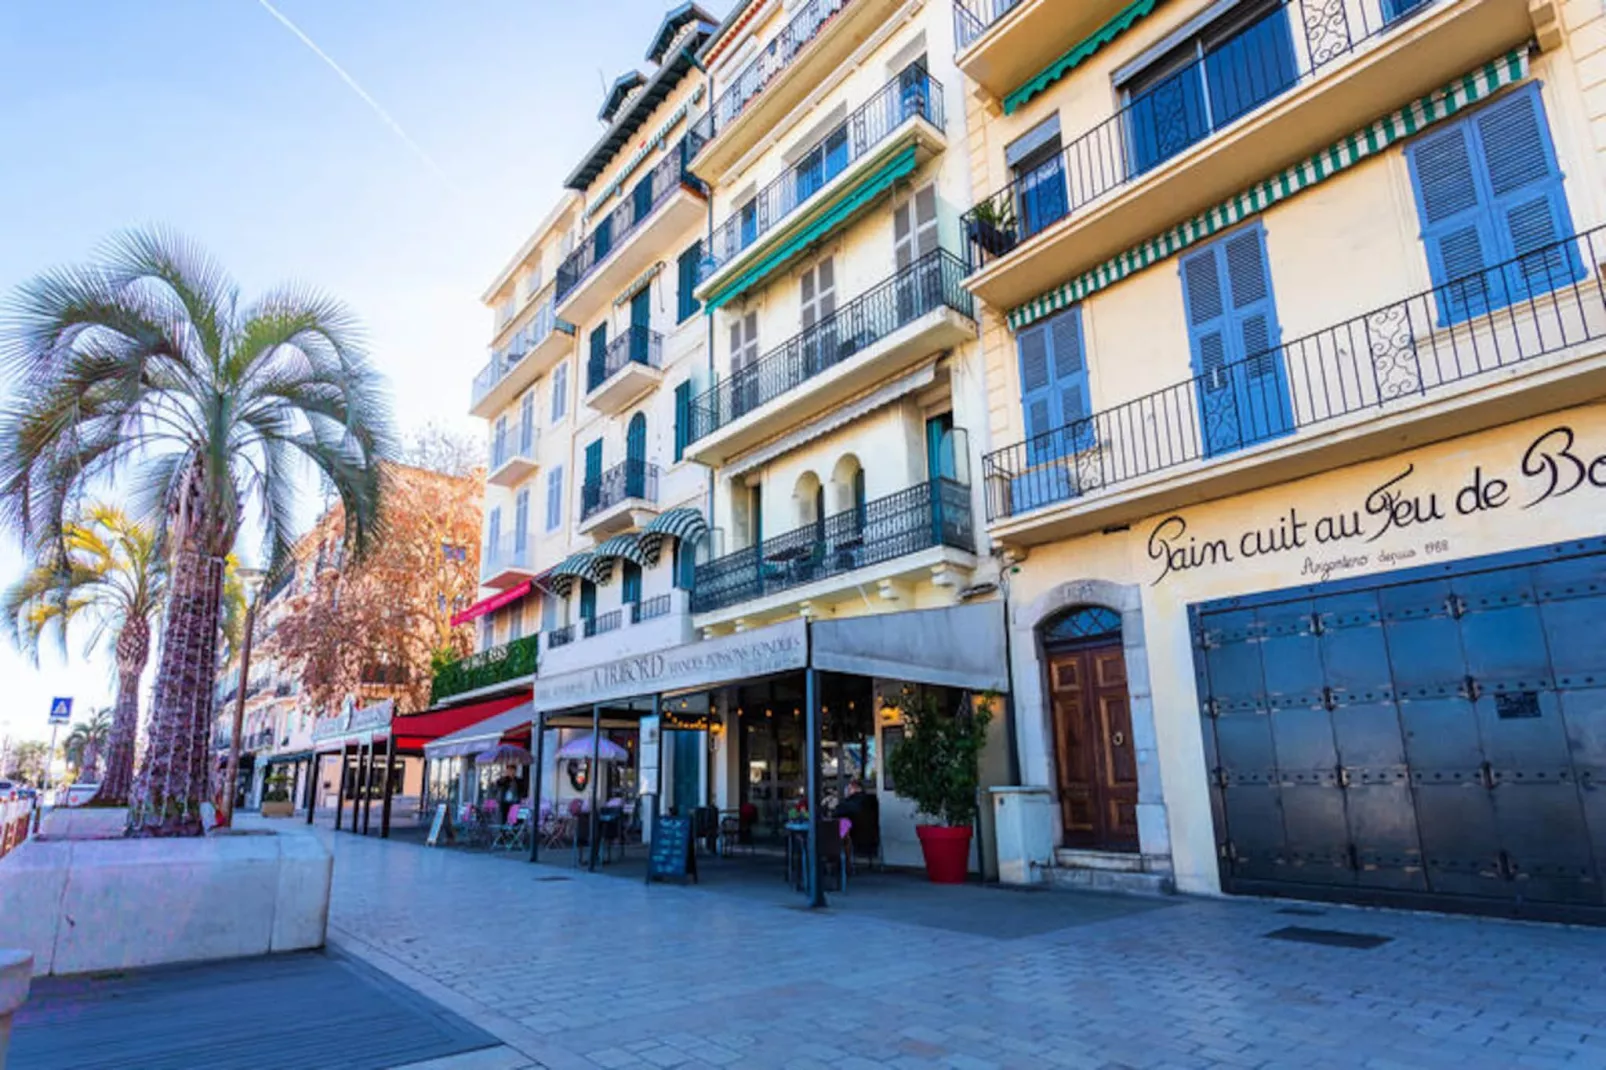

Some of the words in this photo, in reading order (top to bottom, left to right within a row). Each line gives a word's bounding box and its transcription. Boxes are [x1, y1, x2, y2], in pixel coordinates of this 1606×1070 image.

[1147, 514, 1233, 586] Pain
[1239, 508, 1308, 558] cuit
[1313, 509, 1364, 543] au
[1364, 463, 1445, 543] Feu
[1454, 466, 1510, 512] de
